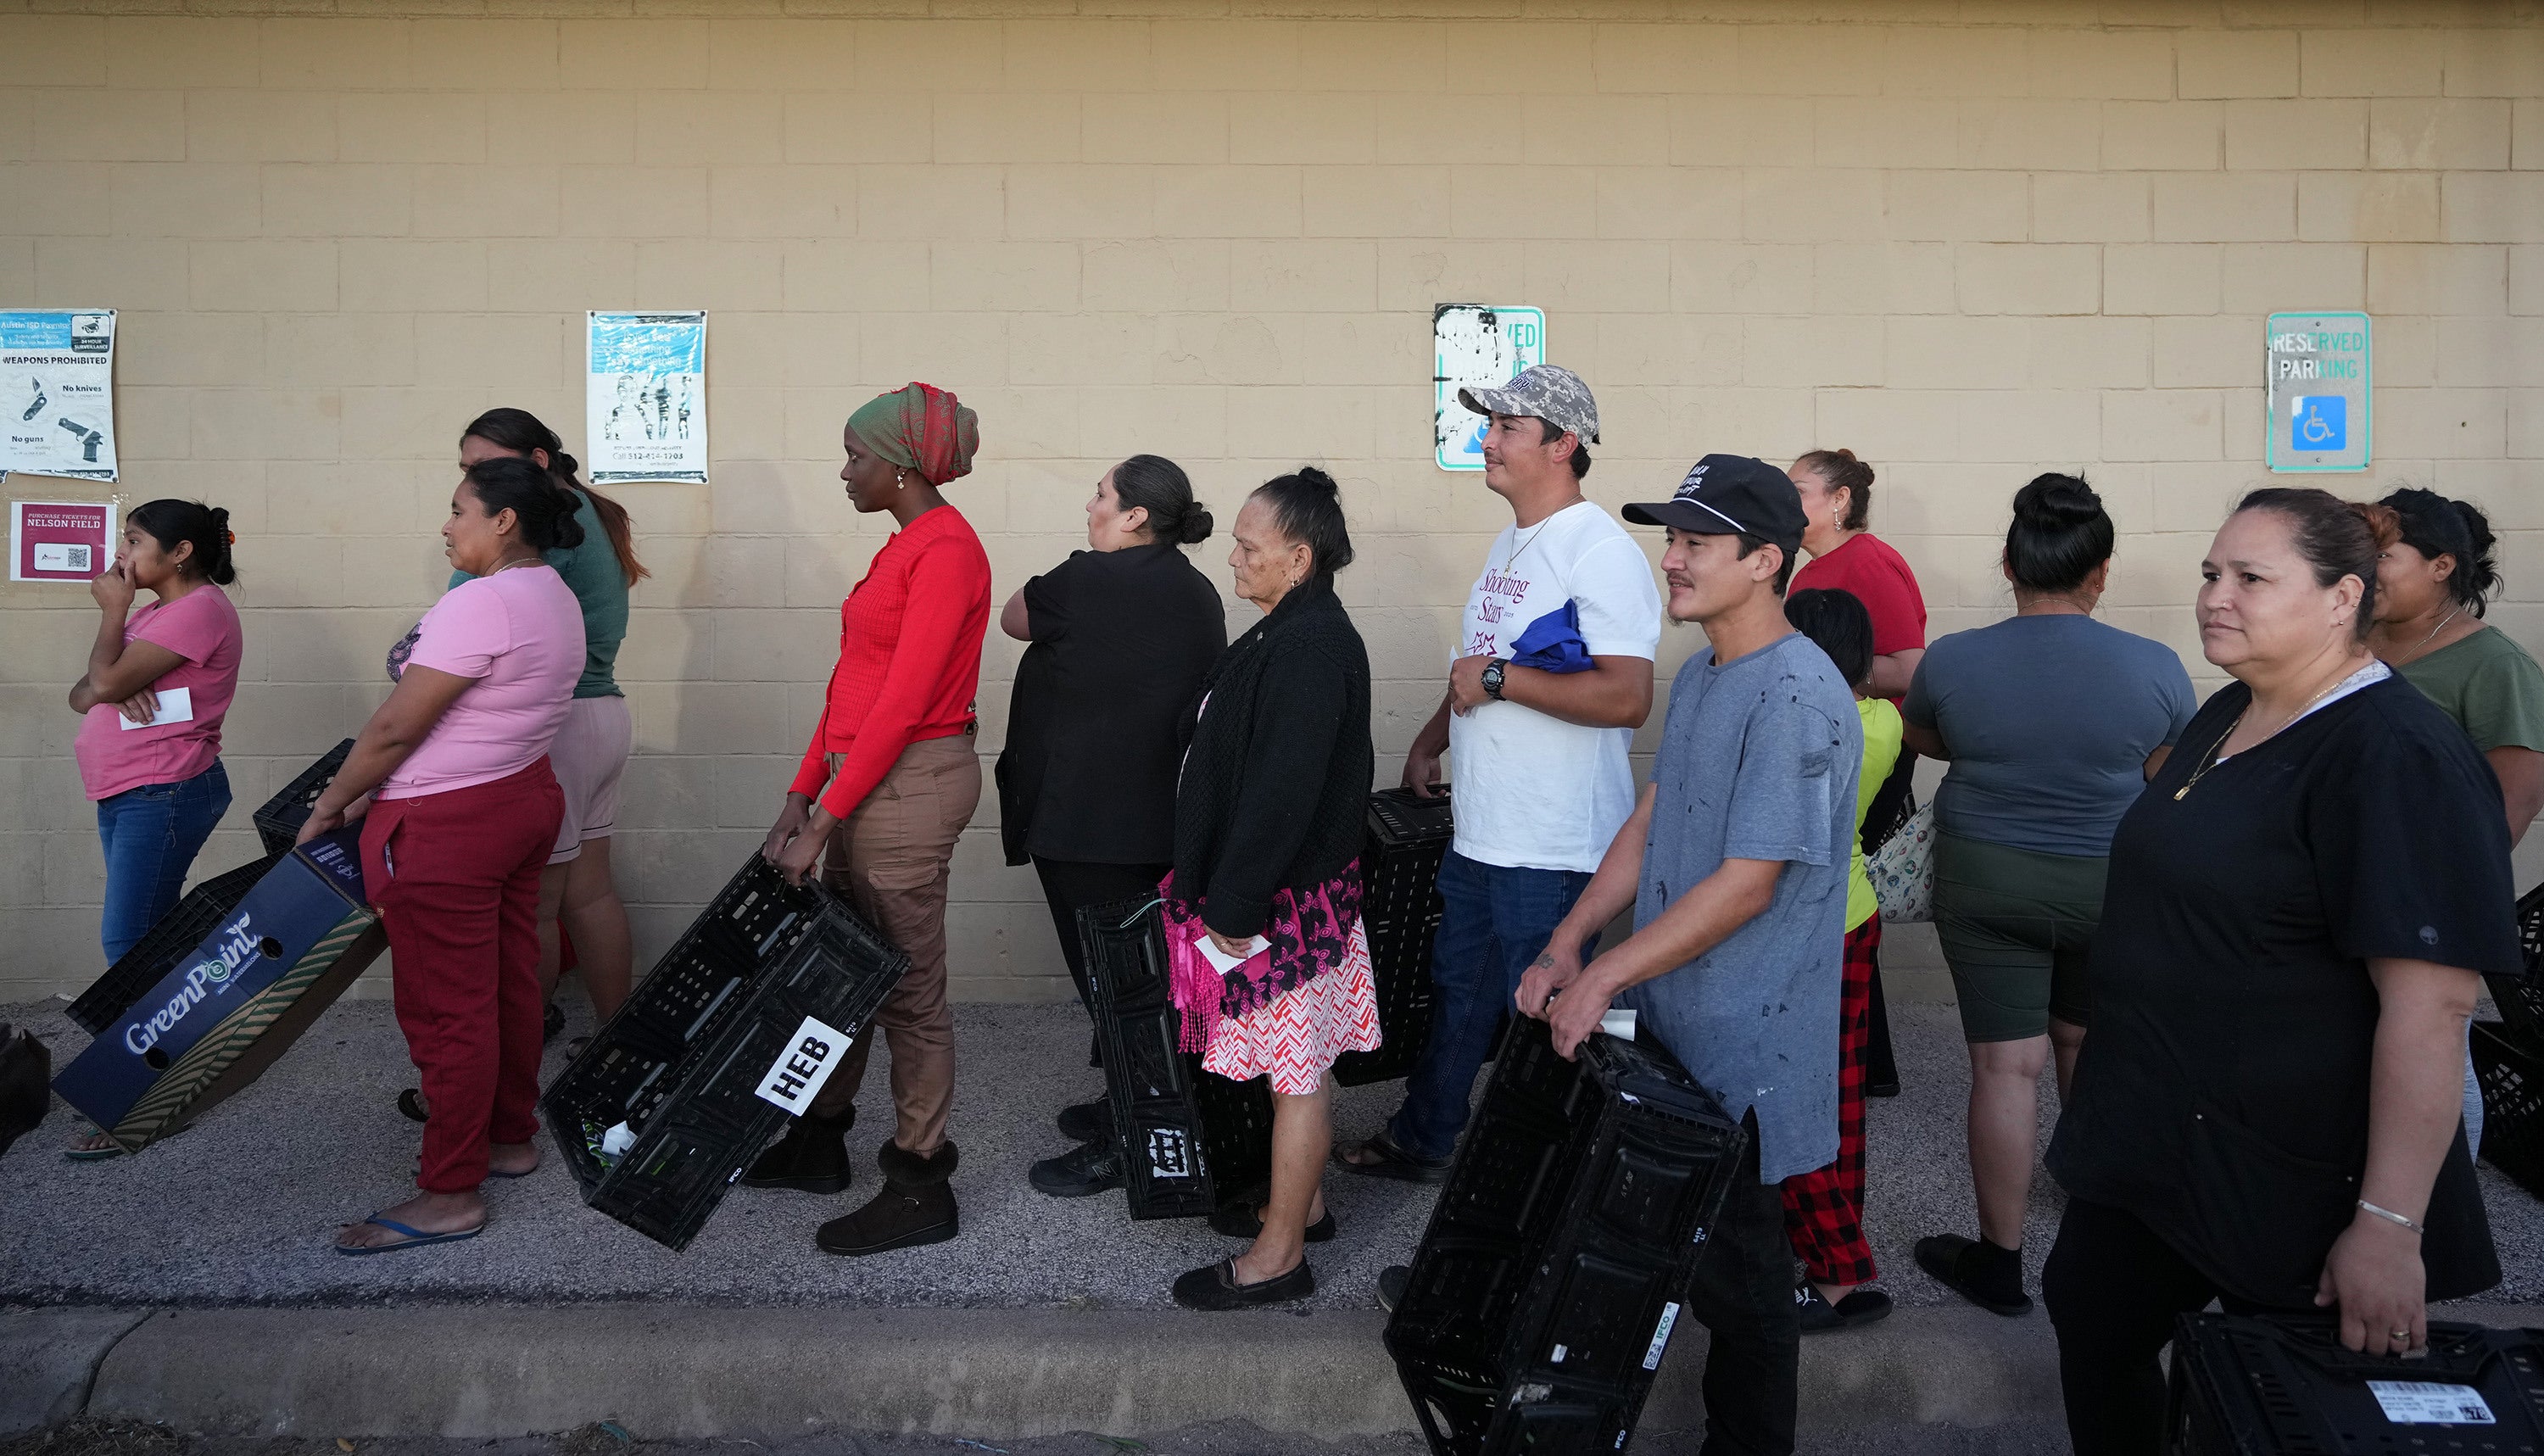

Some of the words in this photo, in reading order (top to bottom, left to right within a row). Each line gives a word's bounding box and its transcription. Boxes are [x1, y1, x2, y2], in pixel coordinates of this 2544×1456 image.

[2273, 332, 2363, 353] RESERVED
[3, 356, 49, 365] WEAPONS
[51, 356, 107, 365] PROHIBITED
[2280, 360, 2357, 380] PARKING
[27, 519, 68, 528] NELSON
[70, 520, 101, 528] FIELD
[1479, 568, 1530, 604] Shooting
[1477, 596, 1504, 623] Stars
[771, 1035, 831, 1101] HEB
[1656, 1315, 1670, 1339] IFCO
[1614, 1430, 1626, 1449] IFCO
